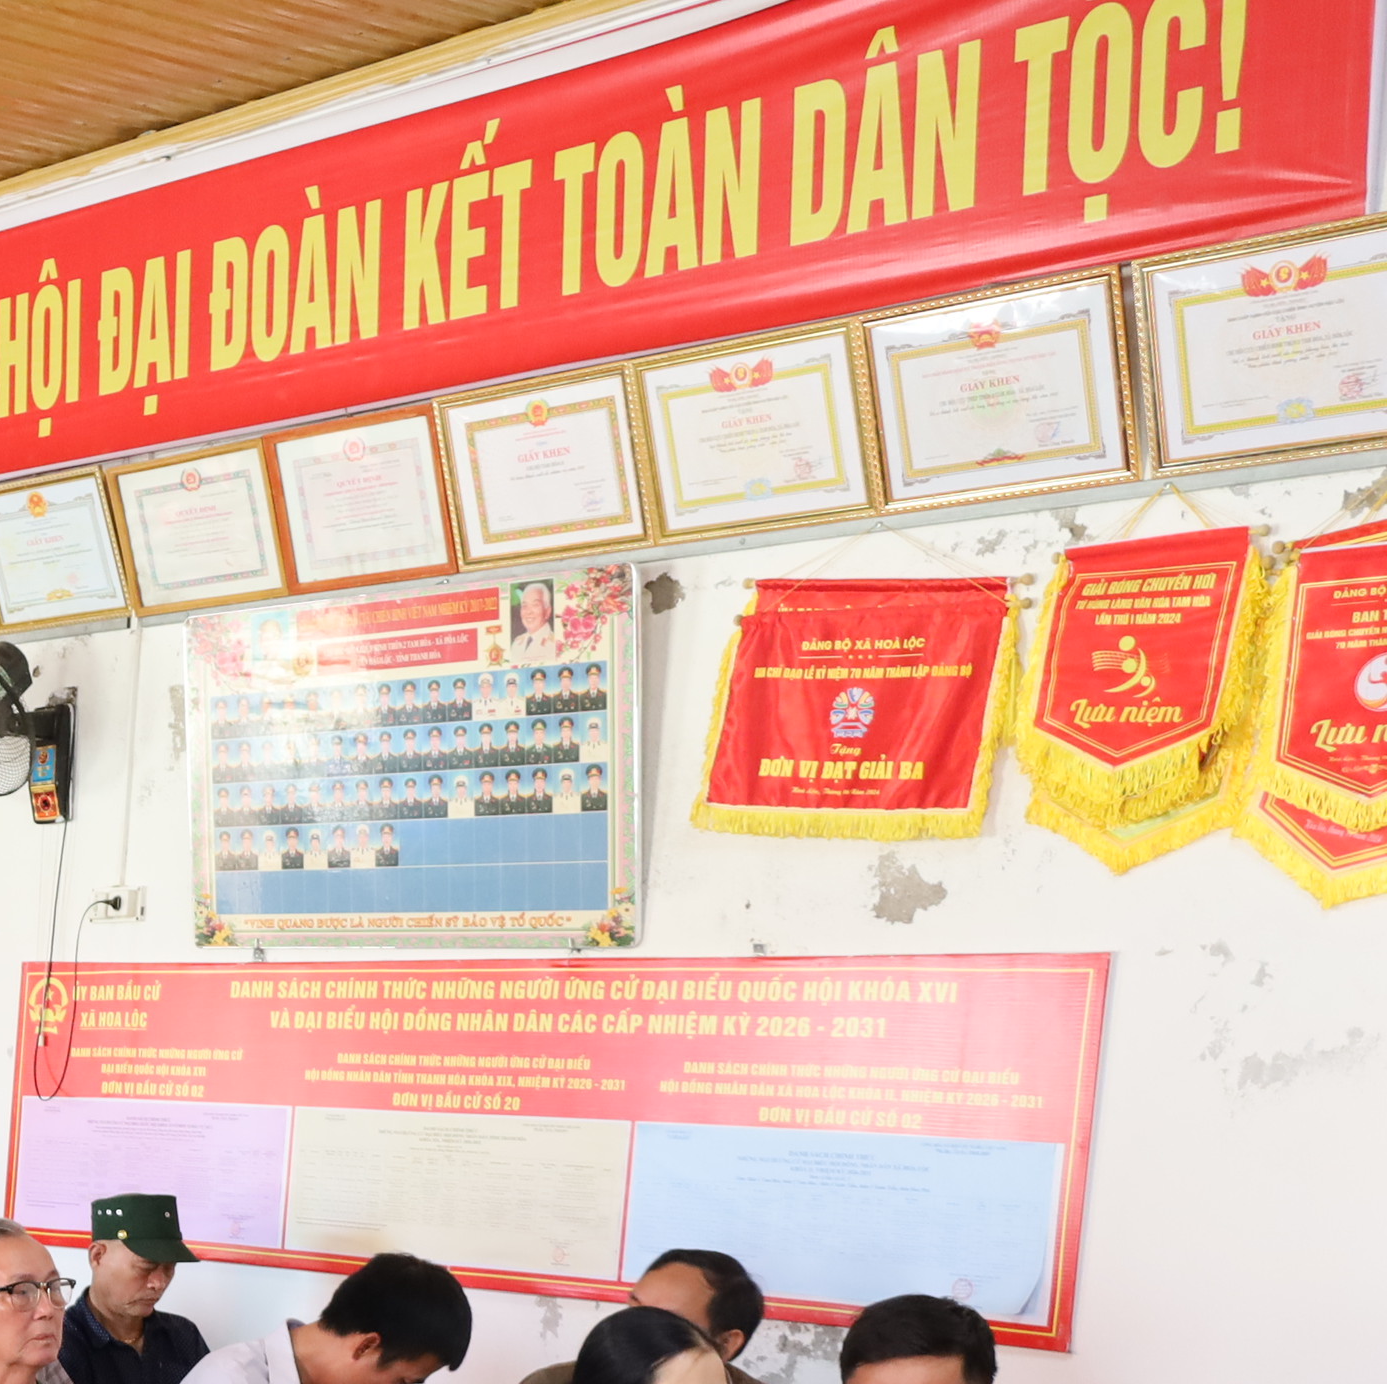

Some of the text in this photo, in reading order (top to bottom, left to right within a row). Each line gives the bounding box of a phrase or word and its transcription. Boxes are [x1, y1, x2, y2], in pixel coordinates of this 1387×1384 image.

[98, 250, 191, 415] ĐẠI
[209, 186, 382, 371] ĐOÀN
[403, 118, 532, 330] KẾT
[554, 85, 762, 296] TOÀN
[790, 26, 982, 246] DÂN
[1015, 0, 1247, 224] TỘC!
[1252, 321, 1322, 341] GIẤY KHEN
[959, 375, 1020, 394] GIẤY KHEN
[721, 413, 772, 430] GIẤY KHEN
[517, 446, 571, 464] GIẤY KHEN
[1081, 571, 1217, 596] GIẢI BÓNG CHUYỀN HƠI
[1333, 584, 1387, 599] ĐẢNG BỘ
[1172, 597, 1191, 607] TAM
[1094, 612, 1112, 625] LẦN
[1113, 613, 1130, 625] THỨ
[1135, 613, 1157, 624] NĂM
[1157, 613, 1182, 624] 2024
[1352, 610, 1380, 623] BAN
[801, 637, 832, 651] ĐẢNG
[834, 638, 852, 653] BỘ
[854, 637, 872, 650] XÃ
[902, 635, 926, 651] LỘC
[1069, 696, 1183, 728] Lưu niệm
[1310, 718, 1368, 752] Lưu
[829, 743, 862, 757] Tặng
[758, 754, 924, 784] ĐƠN VỊ ĐẠT GIẢI BA
[72, 979, 162, 1002] ỦY BAN BẦU CỬ
[230, 973, 958, 1005] DANH SÁCH CHÍNH THỨC NHỮNG NGƯỜI ỨNG CỬ ĐẠI BIỂU QUỐC HỘI KHÓA XVI
[80, 1008, 148, 1028] XÃ HOA LỘC
[271, 1008, 290, 1028] VÀ
[294, 1011, 322, 1032] ĐẠI
[326, 1005, 365, 1029] BIỂU
[369, 1008, 399, 1034] HỘI
[403, 1008, 452, 1031] ĐỒNG
[456, 1009, 509, 1031] NHÂN
[513, 1010, 553, 1032] DÂN
[558, 1010, 597, 1033] CÁC
[602, 1008, 643, 1033] CẤP
[648, 1011, 718, 1039] NHIỆM
[723, 1012, 751, 1035] KỲ
[756, 1016, 811, 1037] 2026
[831, 1017, 886, 1038] 2031
[101, 1079, 205, 1098] ĐƠN VỊ BẦU CỬ SỐ 02
[305, 1069, 320, 1081] HỘI
[319, 1069, 346, 1081] ĐỒNG
[345, 1071, 372, 1082] NHÂN
[371, 1072, 392, 1083] DÂN
[394, 1073, 415, 1084] TỈNH
[414, 1074, 447, 1084] THANH
[446, 1074, 468, 1085] HÓA
[467, 1075, 495, 1086] KHÓA
[494, 1076, 515, 1087] XIX,
[518, 1076, 551, 1088] NHIỆM
[550, 1077, 566, 1088] KỲ
[567, 1078, 594, 1089] 2026
[601, 1079, 625, 1090] 2031
[393, 1091, 521, 1110] ĐƠN VỊ BẦU CỬ SỐ 20
[759, 1106, 923, 1129] ĐƠN VỊ BẦU CỬ SỐ 02
